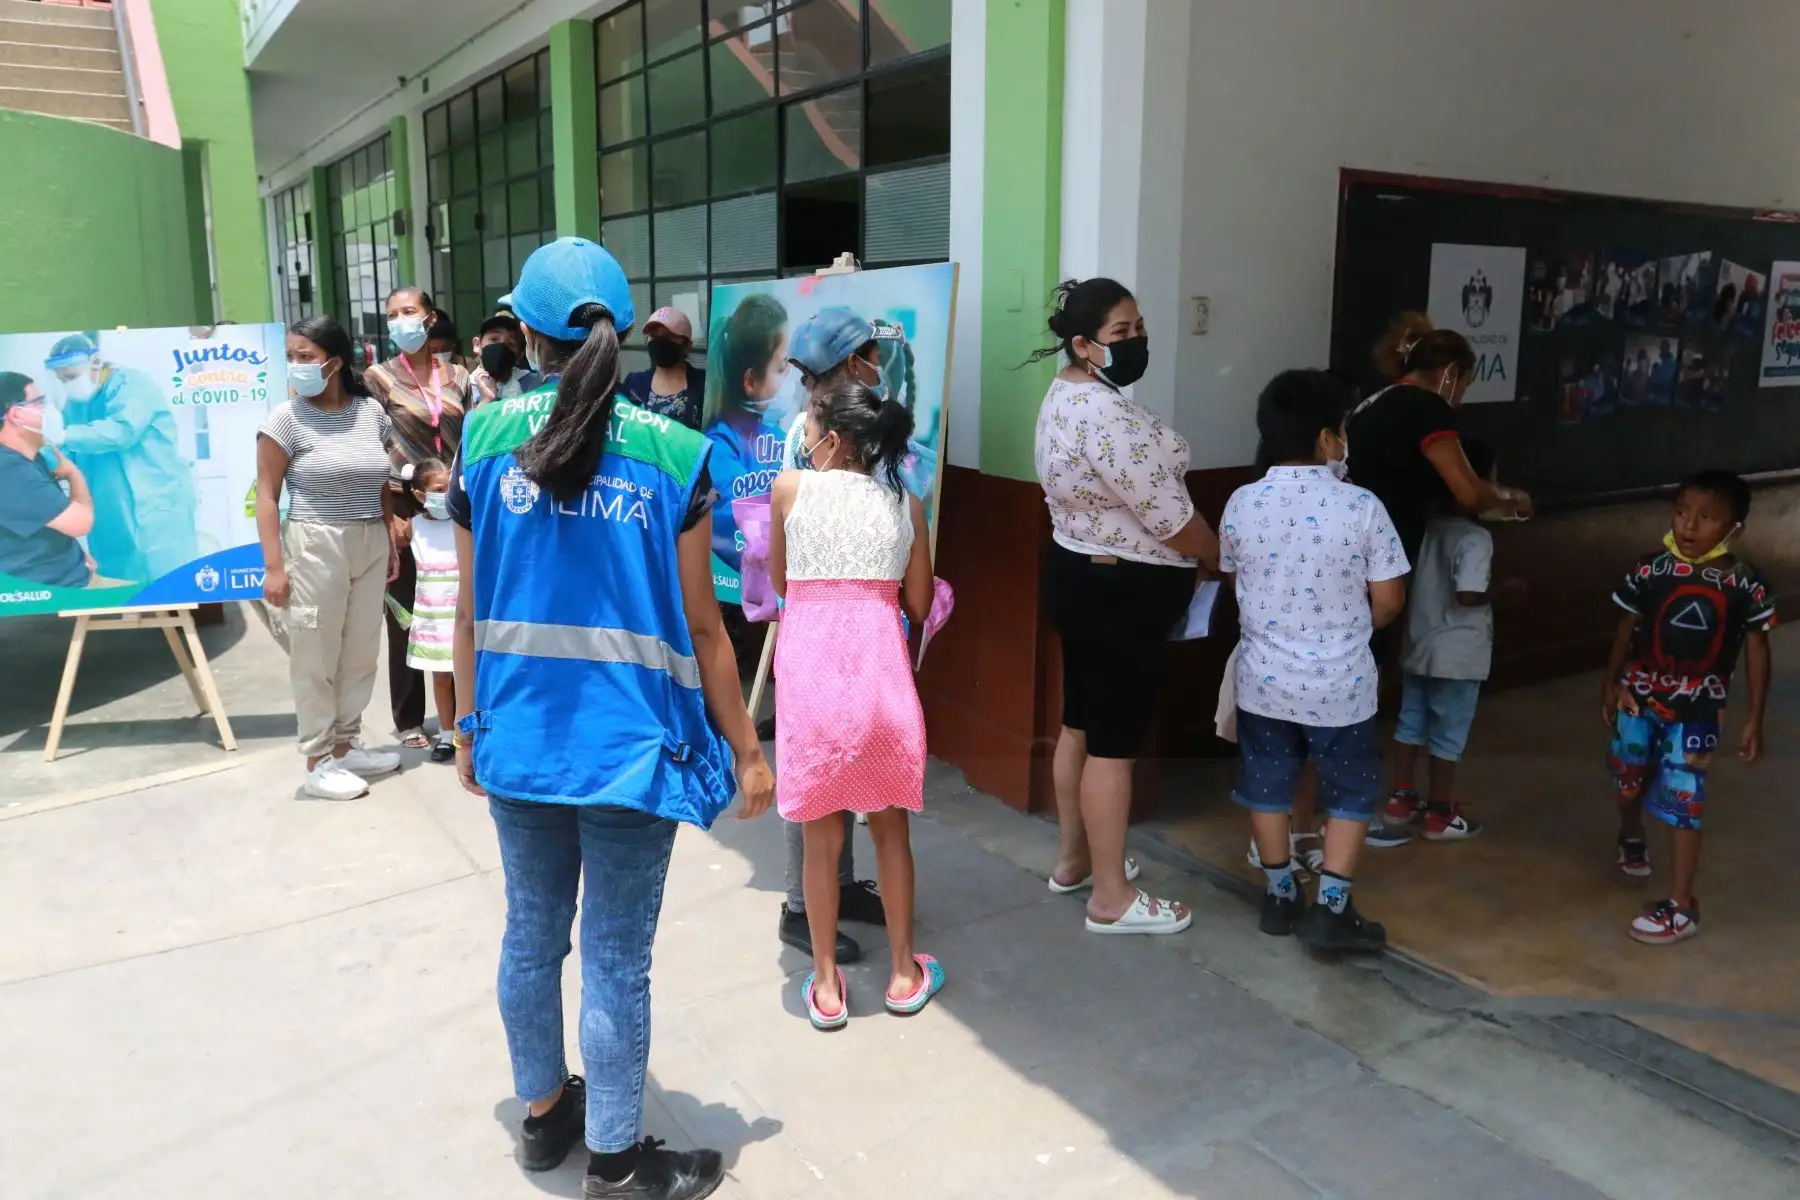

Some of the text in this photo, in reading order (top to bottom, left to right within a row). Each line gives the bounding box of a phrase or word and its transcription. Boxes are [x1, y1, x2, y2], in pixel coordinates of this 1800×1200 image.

[172, 343, 269, 373] Juntos
[188, 369, 249, 386] contra
[172, 391, 187, 406] el
[639, 486, 654, 500] DE
[231, 574, 266, 589] LIM
[718, 575, 740, 589] SALUD
[15, 589, 53, 603] SALUD
